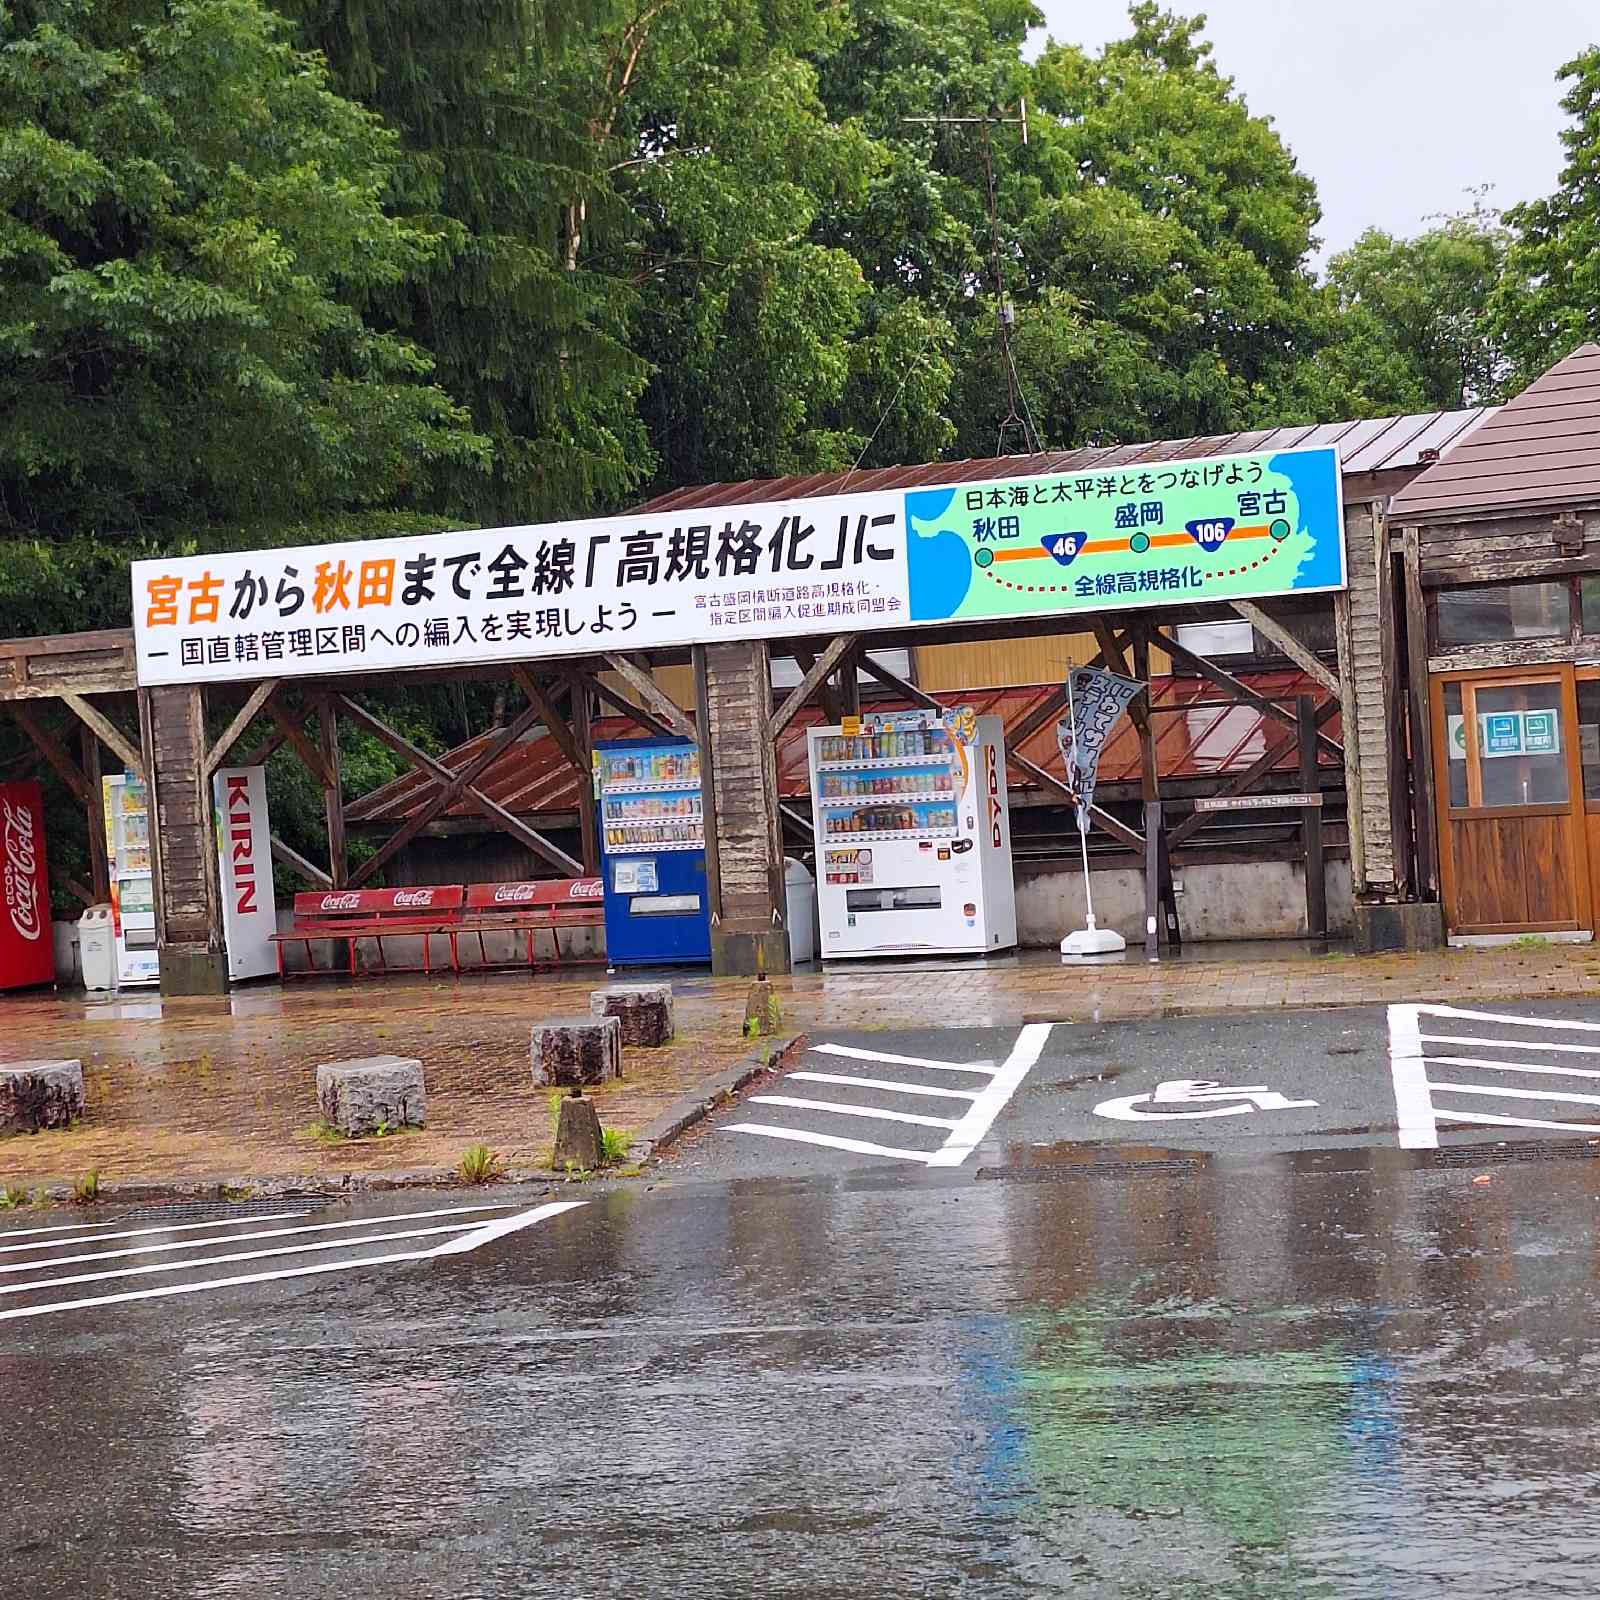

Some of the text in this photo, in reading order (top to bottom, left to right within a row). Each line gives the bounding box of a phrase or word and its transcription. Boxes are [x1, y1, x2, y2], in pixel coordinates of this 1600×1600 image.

[965, 460, 1265, 511] 日本海と太平洋とをつなげよう
[1114, 502, 1164, 529] 盛岡
[1237, 488, 1288, 517] 宮古
[972, 515, 1020, 541] 秋田
[1195, 522, 1226, 542] 106
[1052, 537, 1077, 556] 46
[145, 512, 897, 628] 宮古から秋田まで全線「高規格化」に
[1074, 566, 1203, 597] 全線高規格化
[227, 775, 258, 914] KIRIN
[3, 798, 41, 941] Coca-Cola
[393, 889, 435, 907] Coca-Cola
